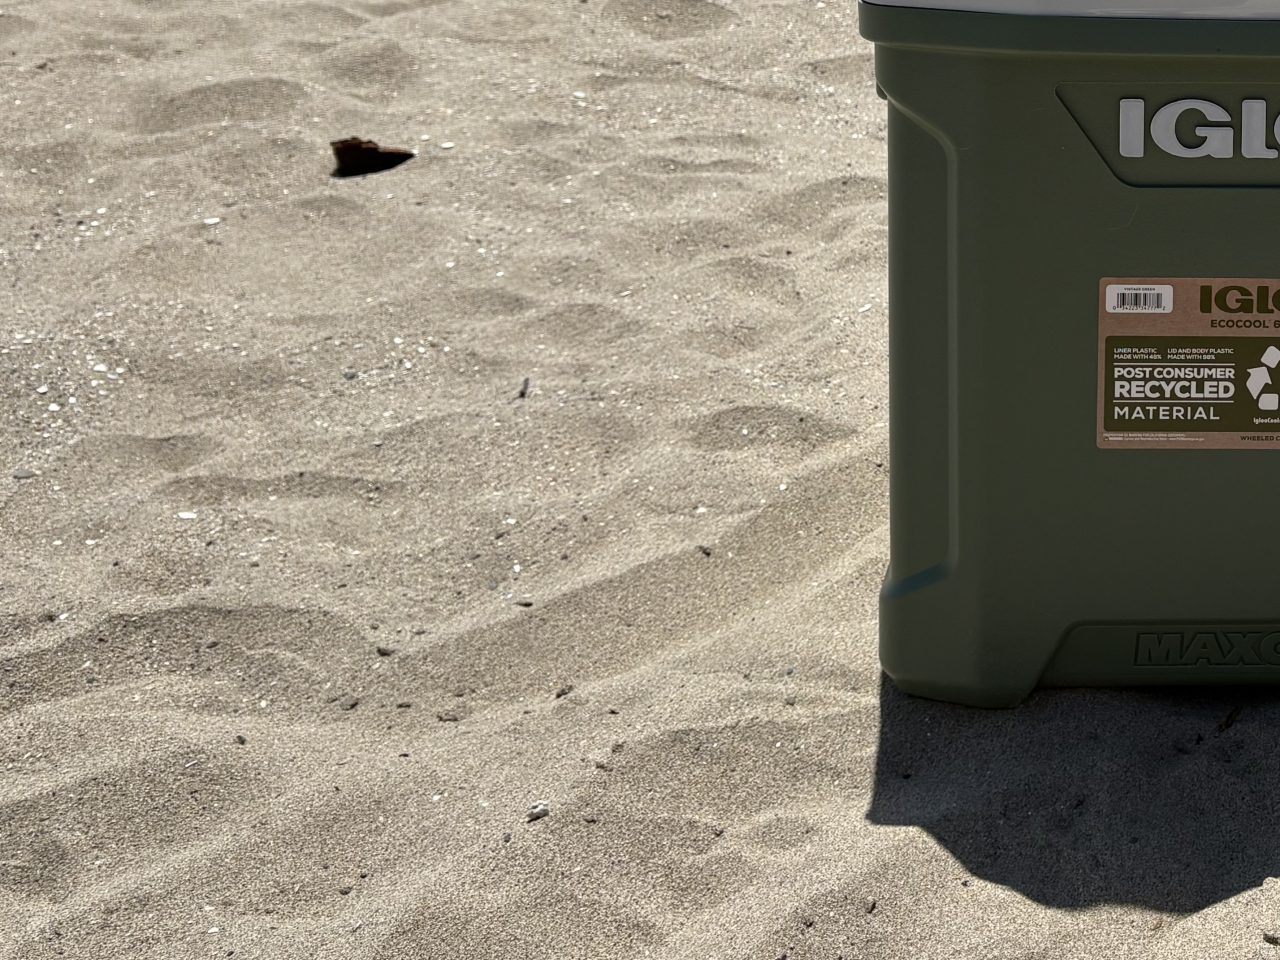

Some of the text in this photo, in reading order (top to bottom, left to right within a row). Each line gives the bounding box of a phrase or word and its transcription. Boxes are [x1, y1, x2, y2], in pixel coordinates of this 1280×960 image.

[1210, 319, 1269, 329] ECOCOOL
[1114, 367, 1235, 379] POST CONSUMER
[1114, 380, 1235, 398] RECYCLED
[1114, 406, 1220, 420] MATERIAL
